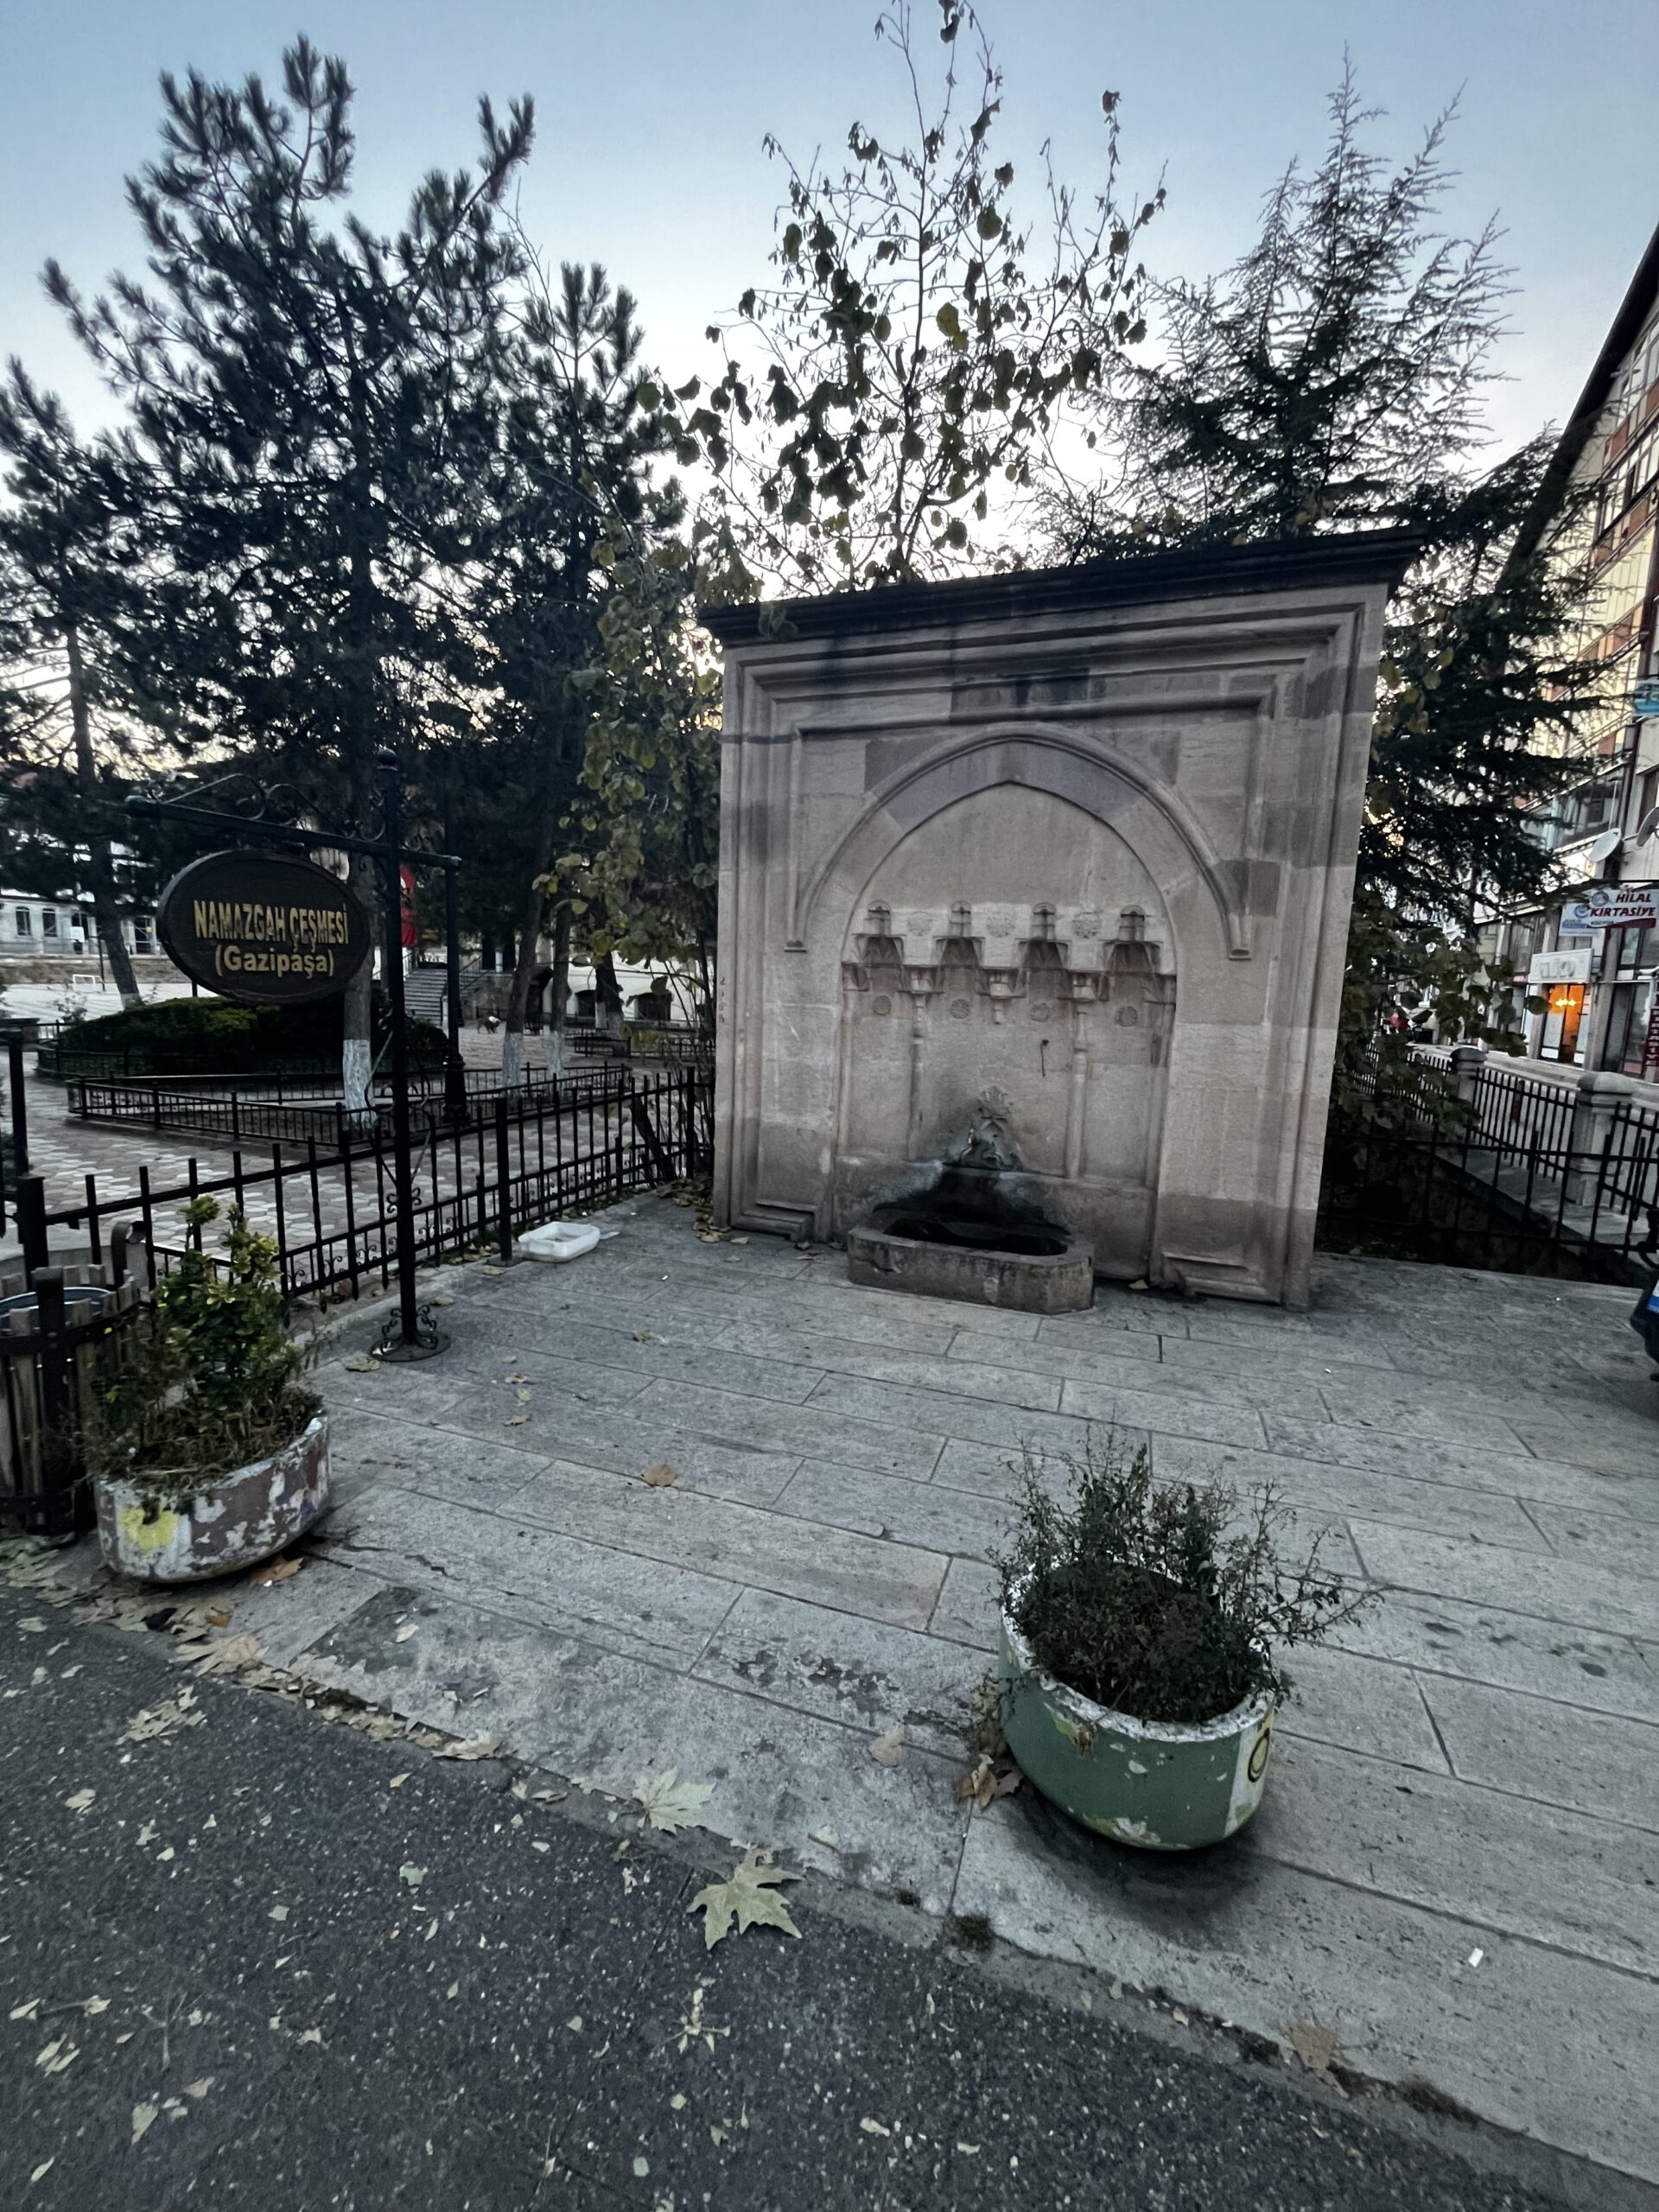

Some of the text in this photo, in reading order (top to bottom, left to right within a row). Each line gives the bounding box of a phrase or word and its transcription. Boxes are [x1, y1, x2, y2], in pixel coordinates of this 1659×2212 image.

[1615, 890, 1651, 903] HİLAL
[1590, 906, 1656, 917] KIRTASİYE
[194, 899, 349, 952] NAMAZGAH ÇEŞMESİ
[215, 944, 334, 980] (Gazipaşa)
